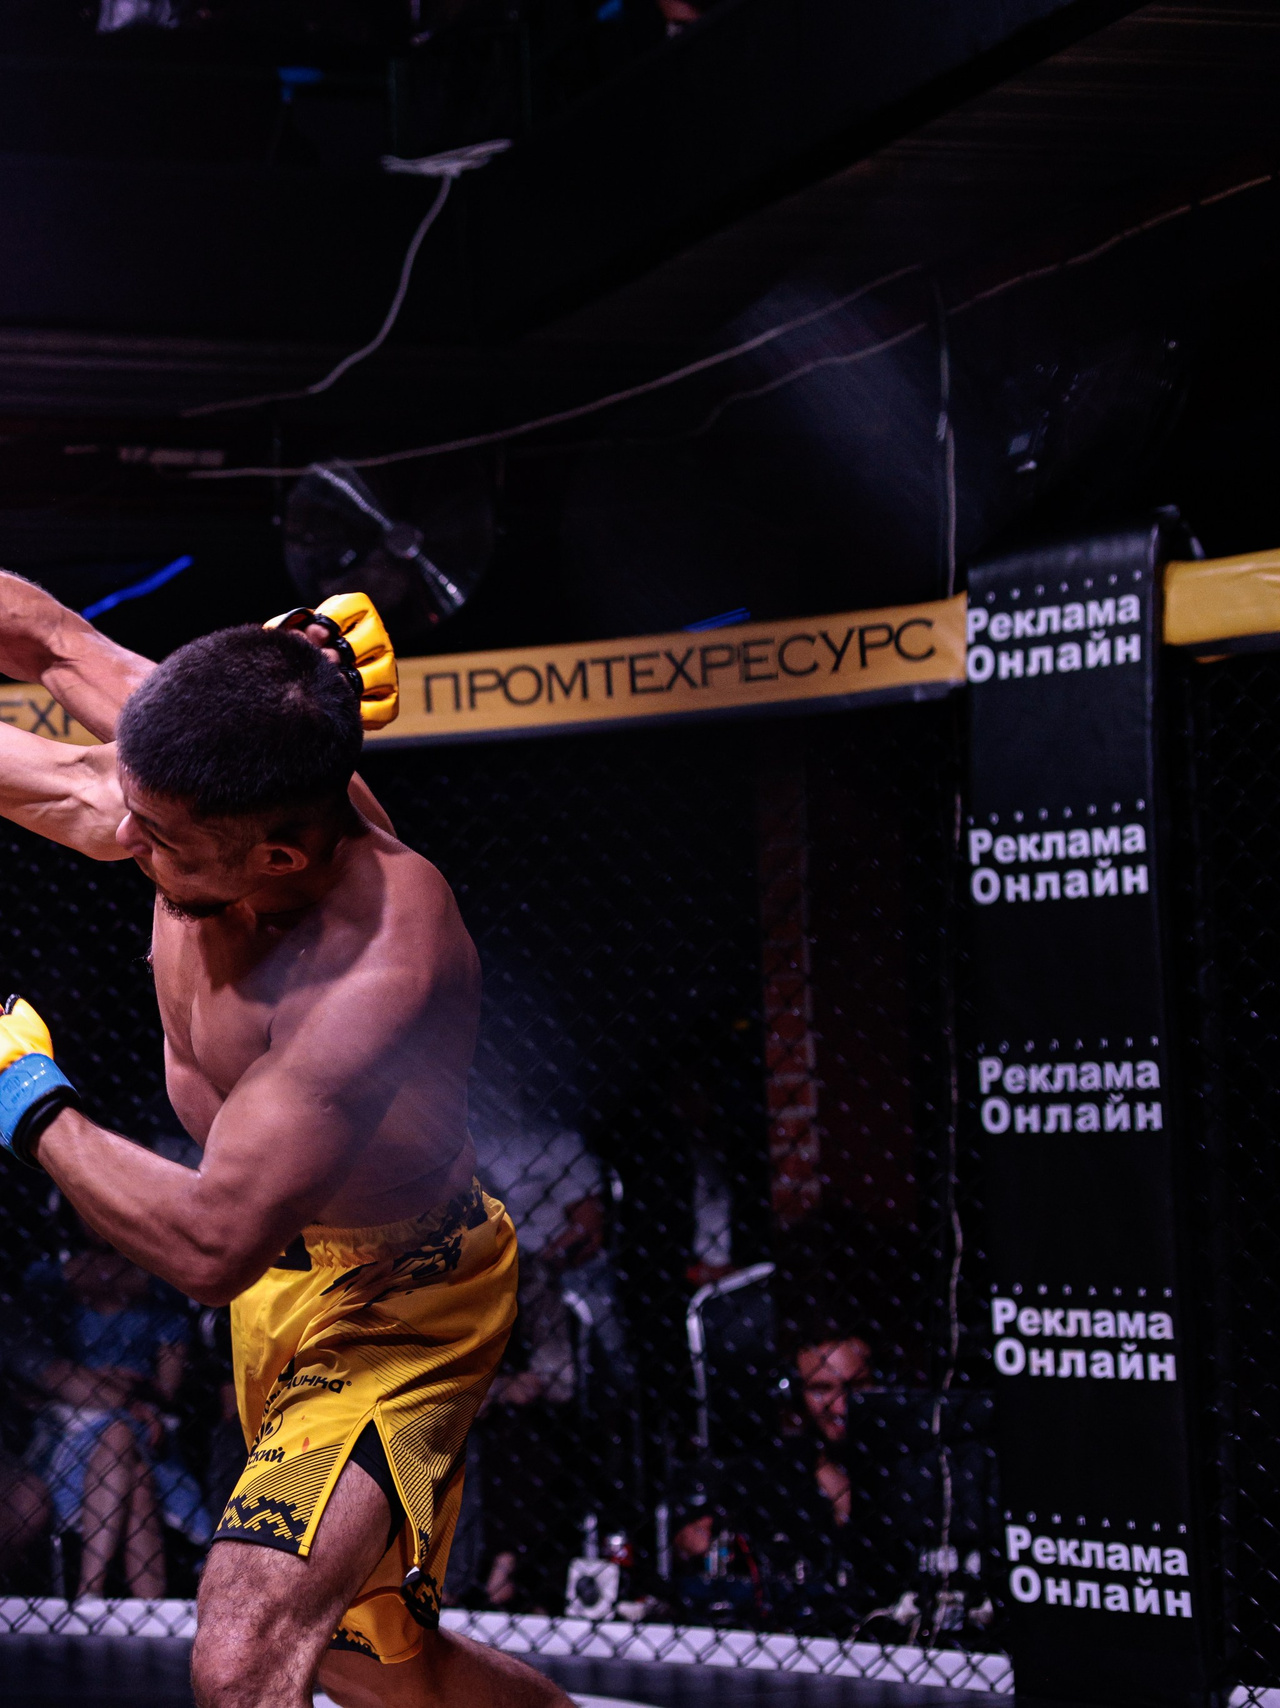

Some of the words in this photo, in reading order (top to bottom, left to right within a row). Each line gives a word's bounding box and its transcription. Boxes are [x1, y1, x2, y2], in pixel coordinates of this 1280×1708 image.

[967, 594, 1141, 645] Реклама
[424, 618, 936, 713] ПРОМТЕХРЕСУРС
[967, 629, 1142, 684] Онлайн
[968, 823, 1146, 865] Реклама
[971, 858, 1149, 905] Онлайн
[978, 1056, 1161, 1094] Реклама
[981, 1093, 1163, 1134] Онлайн
[991, 1297, 1175, 1340] Реклама
[994, 1337, 1177, 1381] Онлайн
[1005, 1524, 1189, 1577] Реклама
[1009, 1565, 1192, 1618] Онлайн
